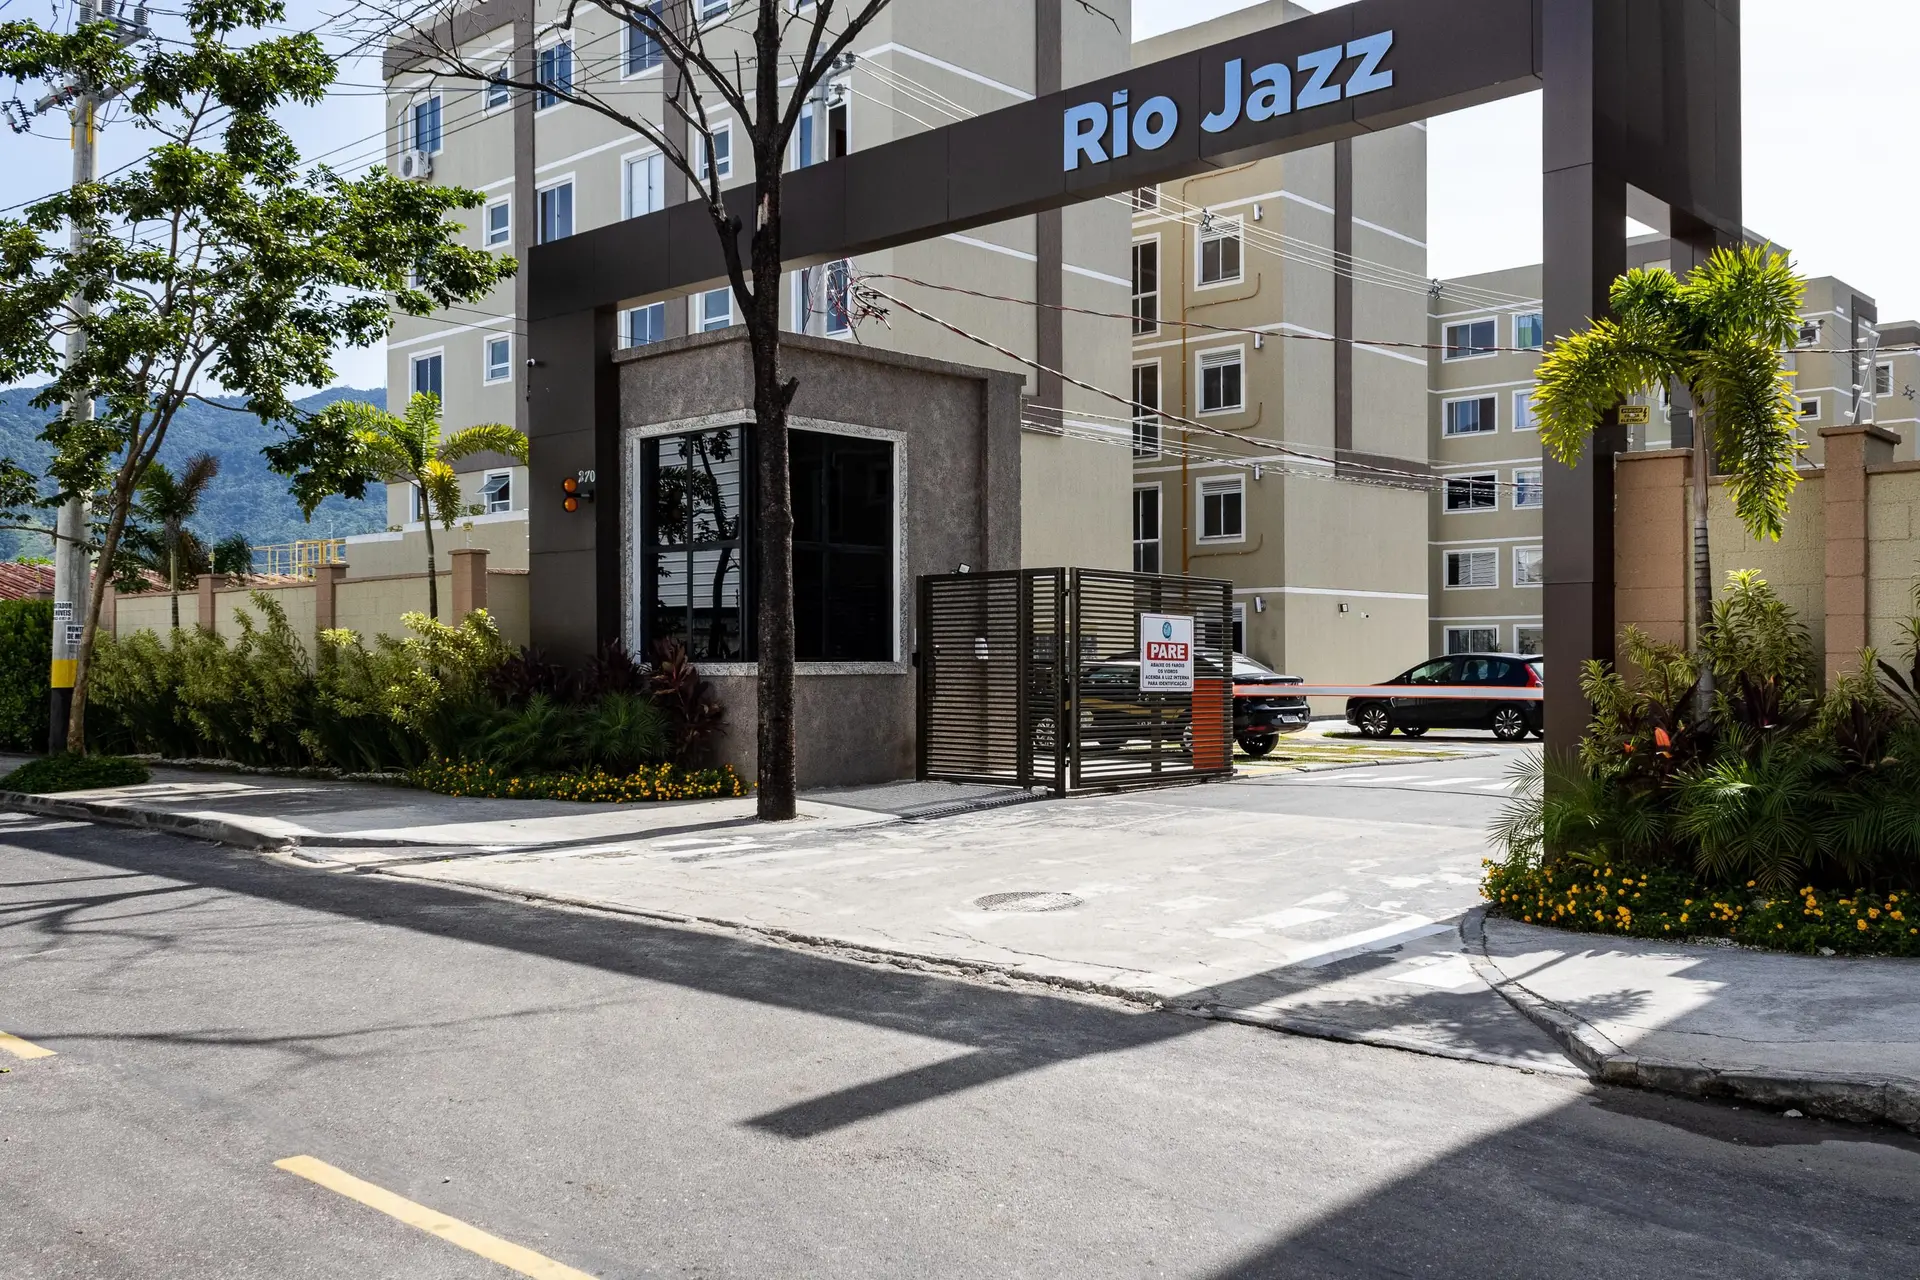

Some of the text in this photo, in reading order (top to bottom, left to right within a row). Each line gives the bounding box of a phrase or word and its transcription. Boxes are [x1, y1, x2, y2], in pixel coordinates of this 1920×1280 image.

[1063, 29, 1393, 172] Rio Jazz
[1150, 643, 1185, 659] PARE
